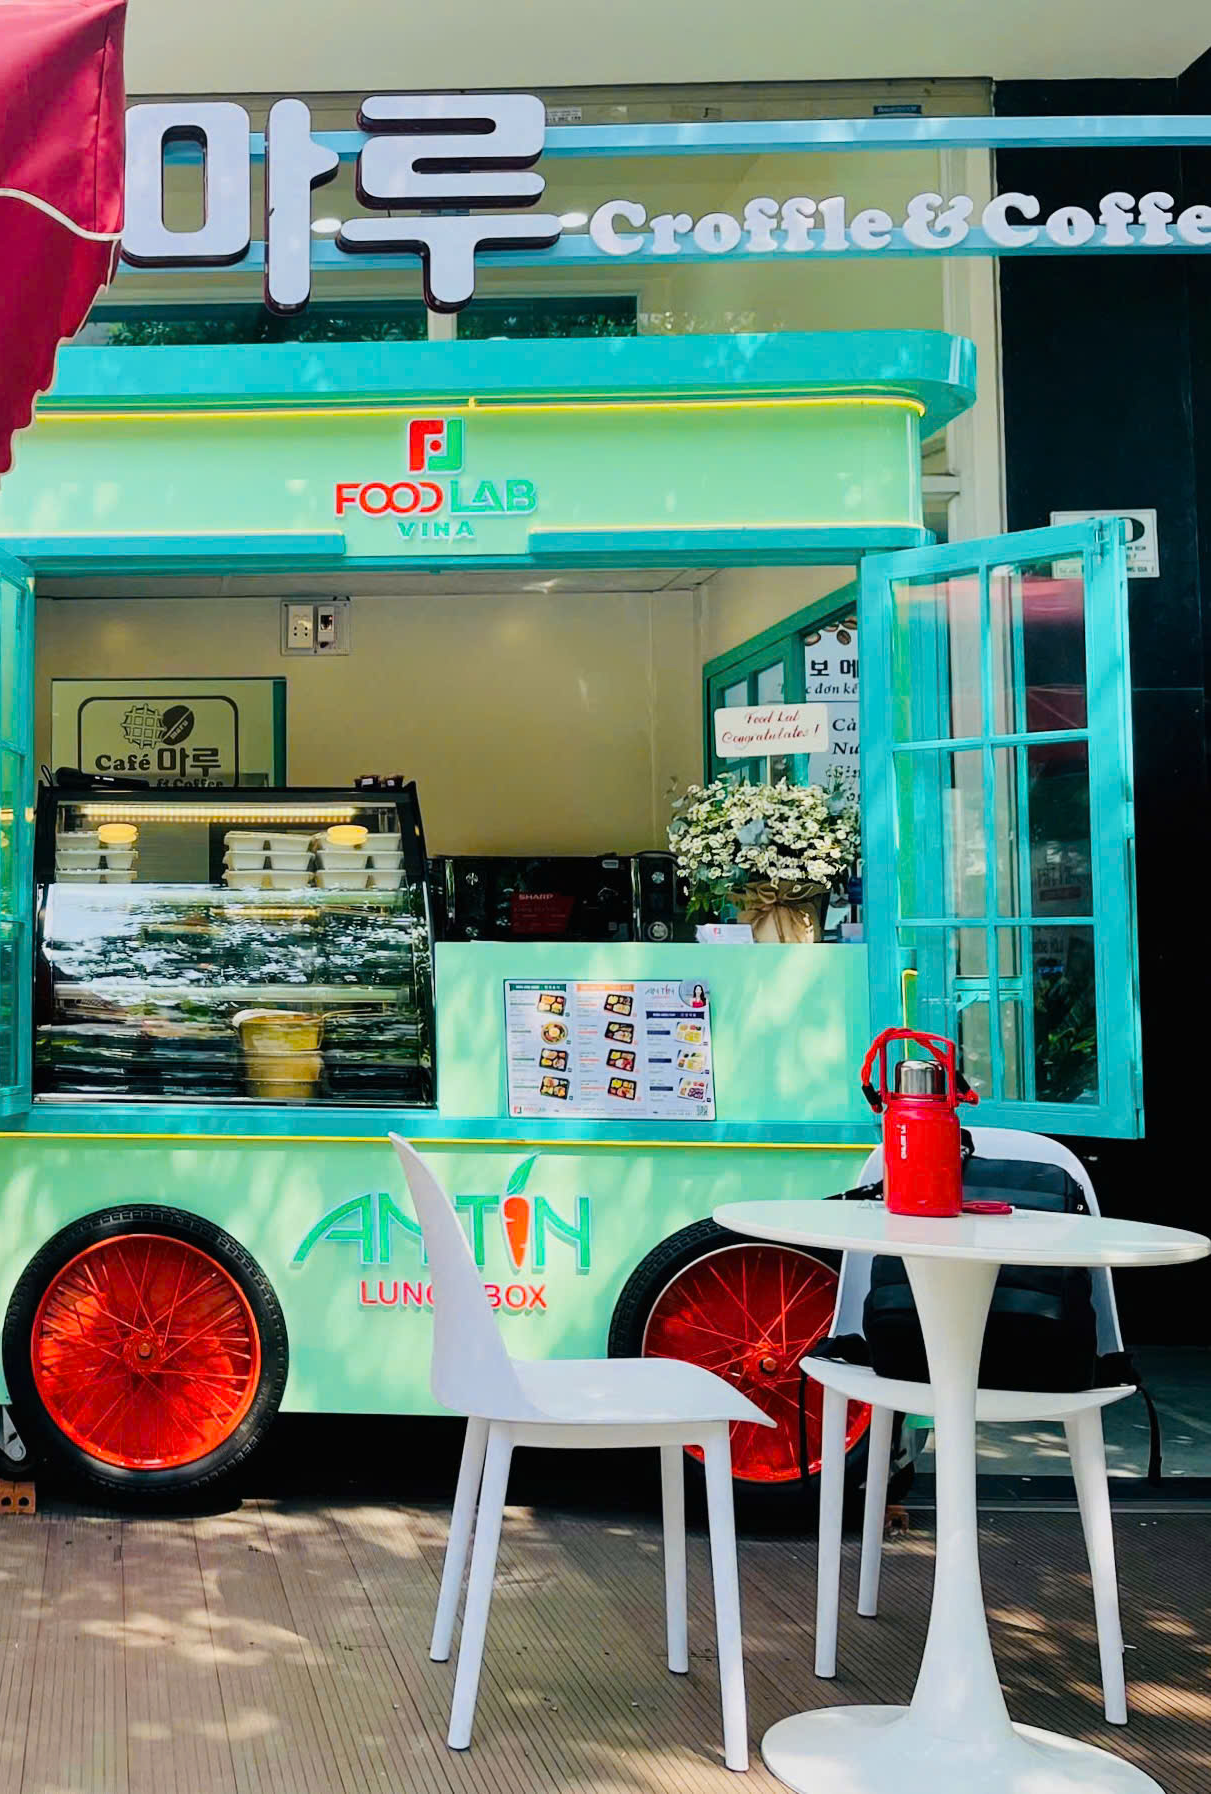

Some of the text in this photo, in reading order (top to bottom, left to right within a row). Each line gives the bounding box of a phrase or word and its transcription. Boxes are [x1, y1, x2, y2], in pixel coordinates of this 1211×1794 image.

[122, 94, 563, 313] 마루
[335, 478, 539, 516] FOOD LAB
[397, 520, 476, 538] VINA
[94, 747, 221, 777] Café 마루
[360, 1280, 434, 1306] LUN
